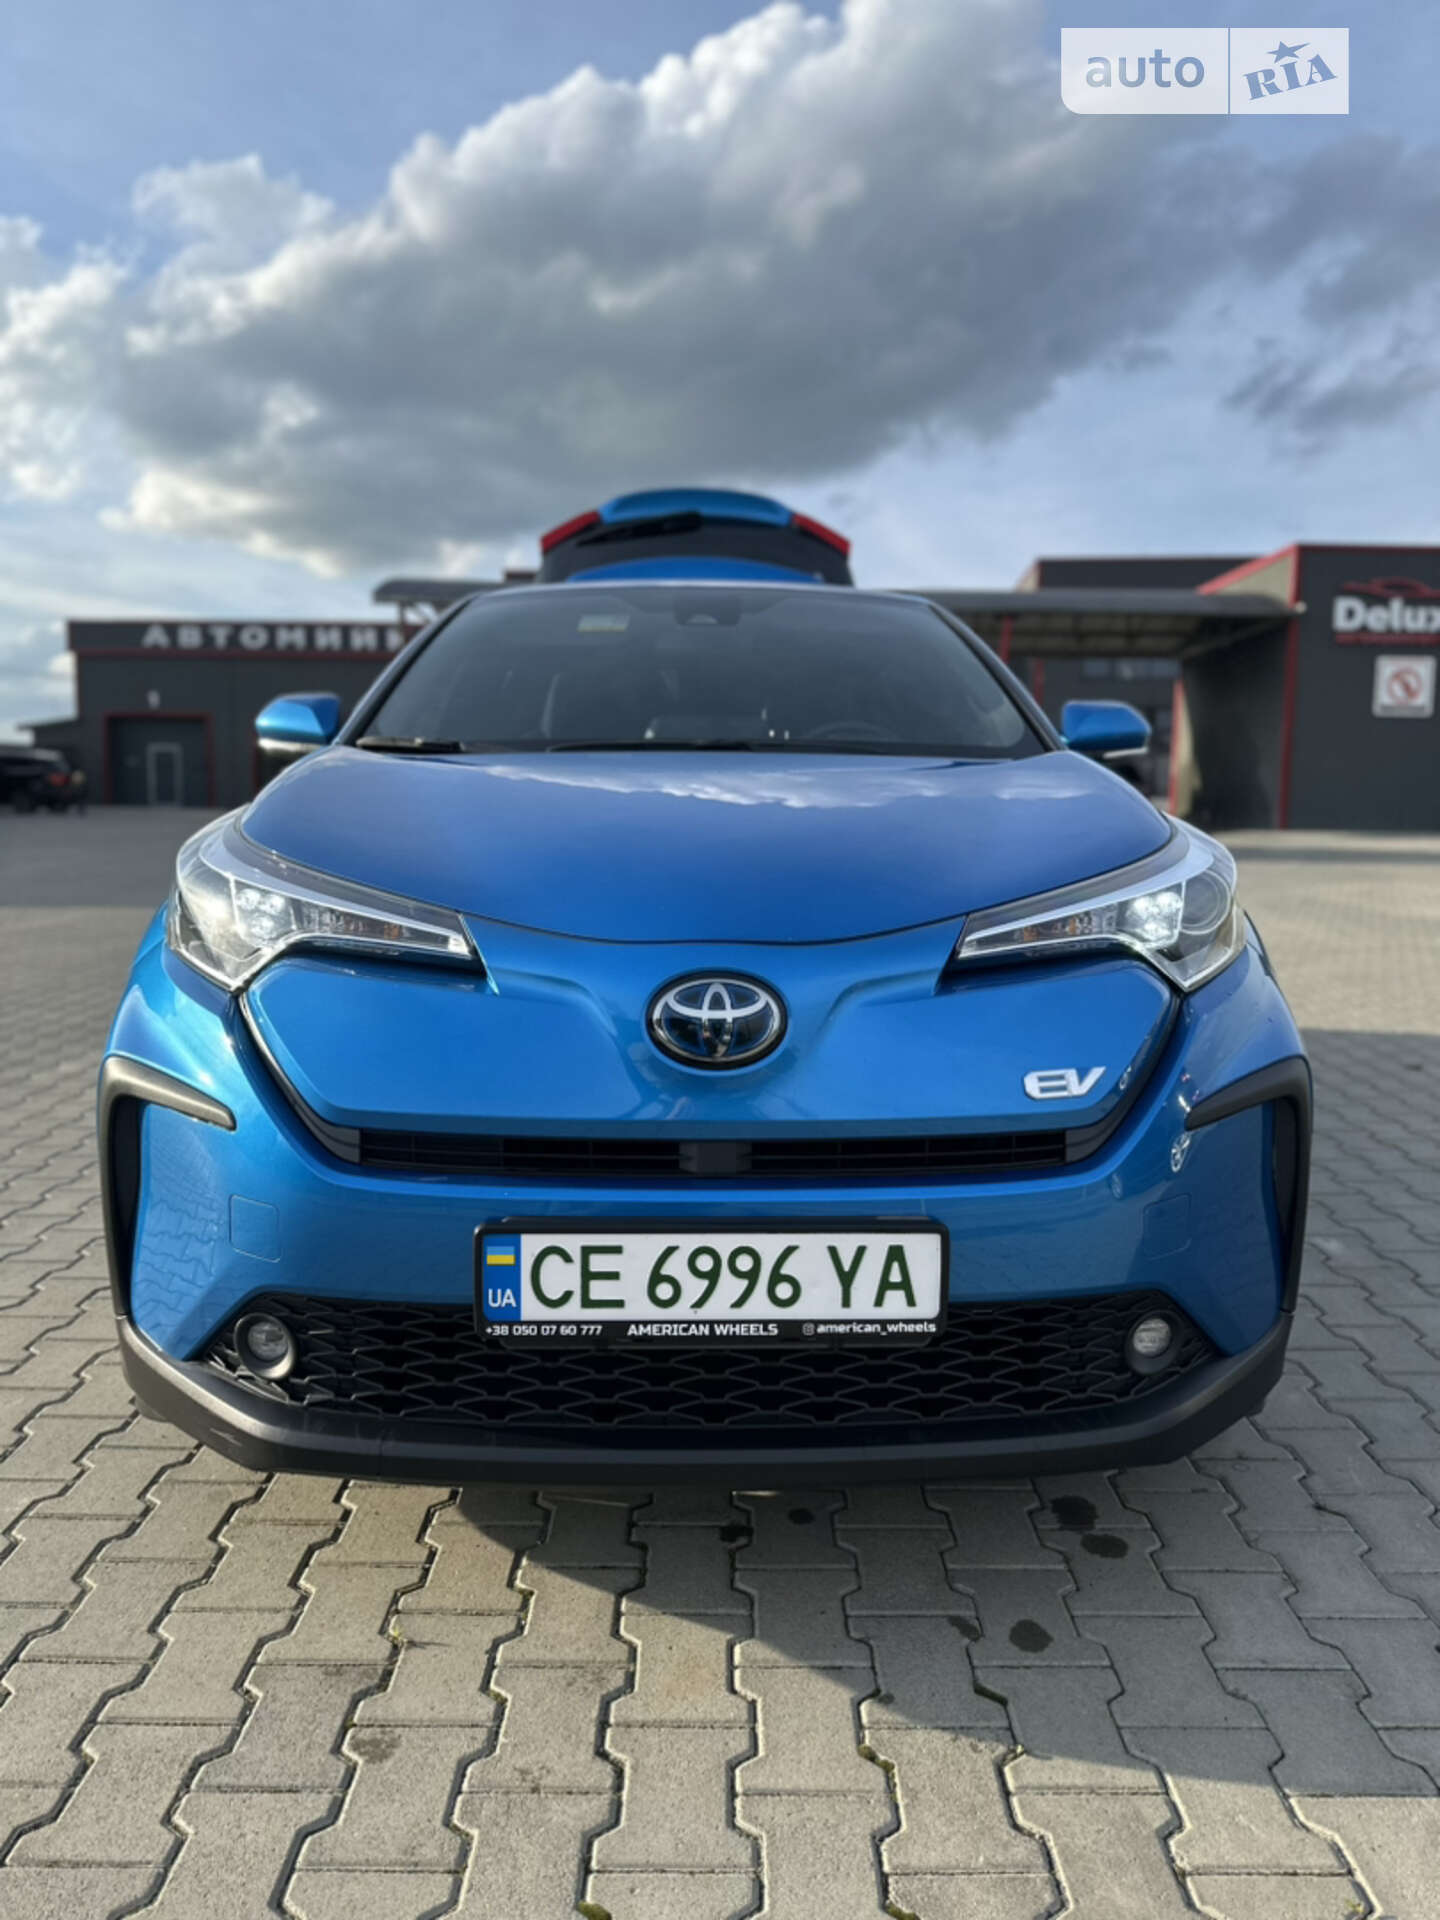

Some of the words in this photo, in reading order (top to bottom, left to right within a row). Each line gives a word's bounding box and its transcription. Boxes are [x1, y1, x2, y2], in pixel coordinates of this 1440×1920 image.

[1023, 1066, 1106, 1100] EV
[530, 1245, 626, 1310] CE
[646, 1245, 803, 1310] 6996
[826, 1244, 917, 1309] YA
[488, 1288, 517, 1308] UA
[485, 1324, 509, 1336] +38
[512, 1324, 538, 1336] 050
[540, 1324, 557, 1336] 07
[580, 1324, 603, 1336] 777
[627, 1324, 710, 1336] AMERICAN
[713, 1323, 779, 1336] WHEELS
